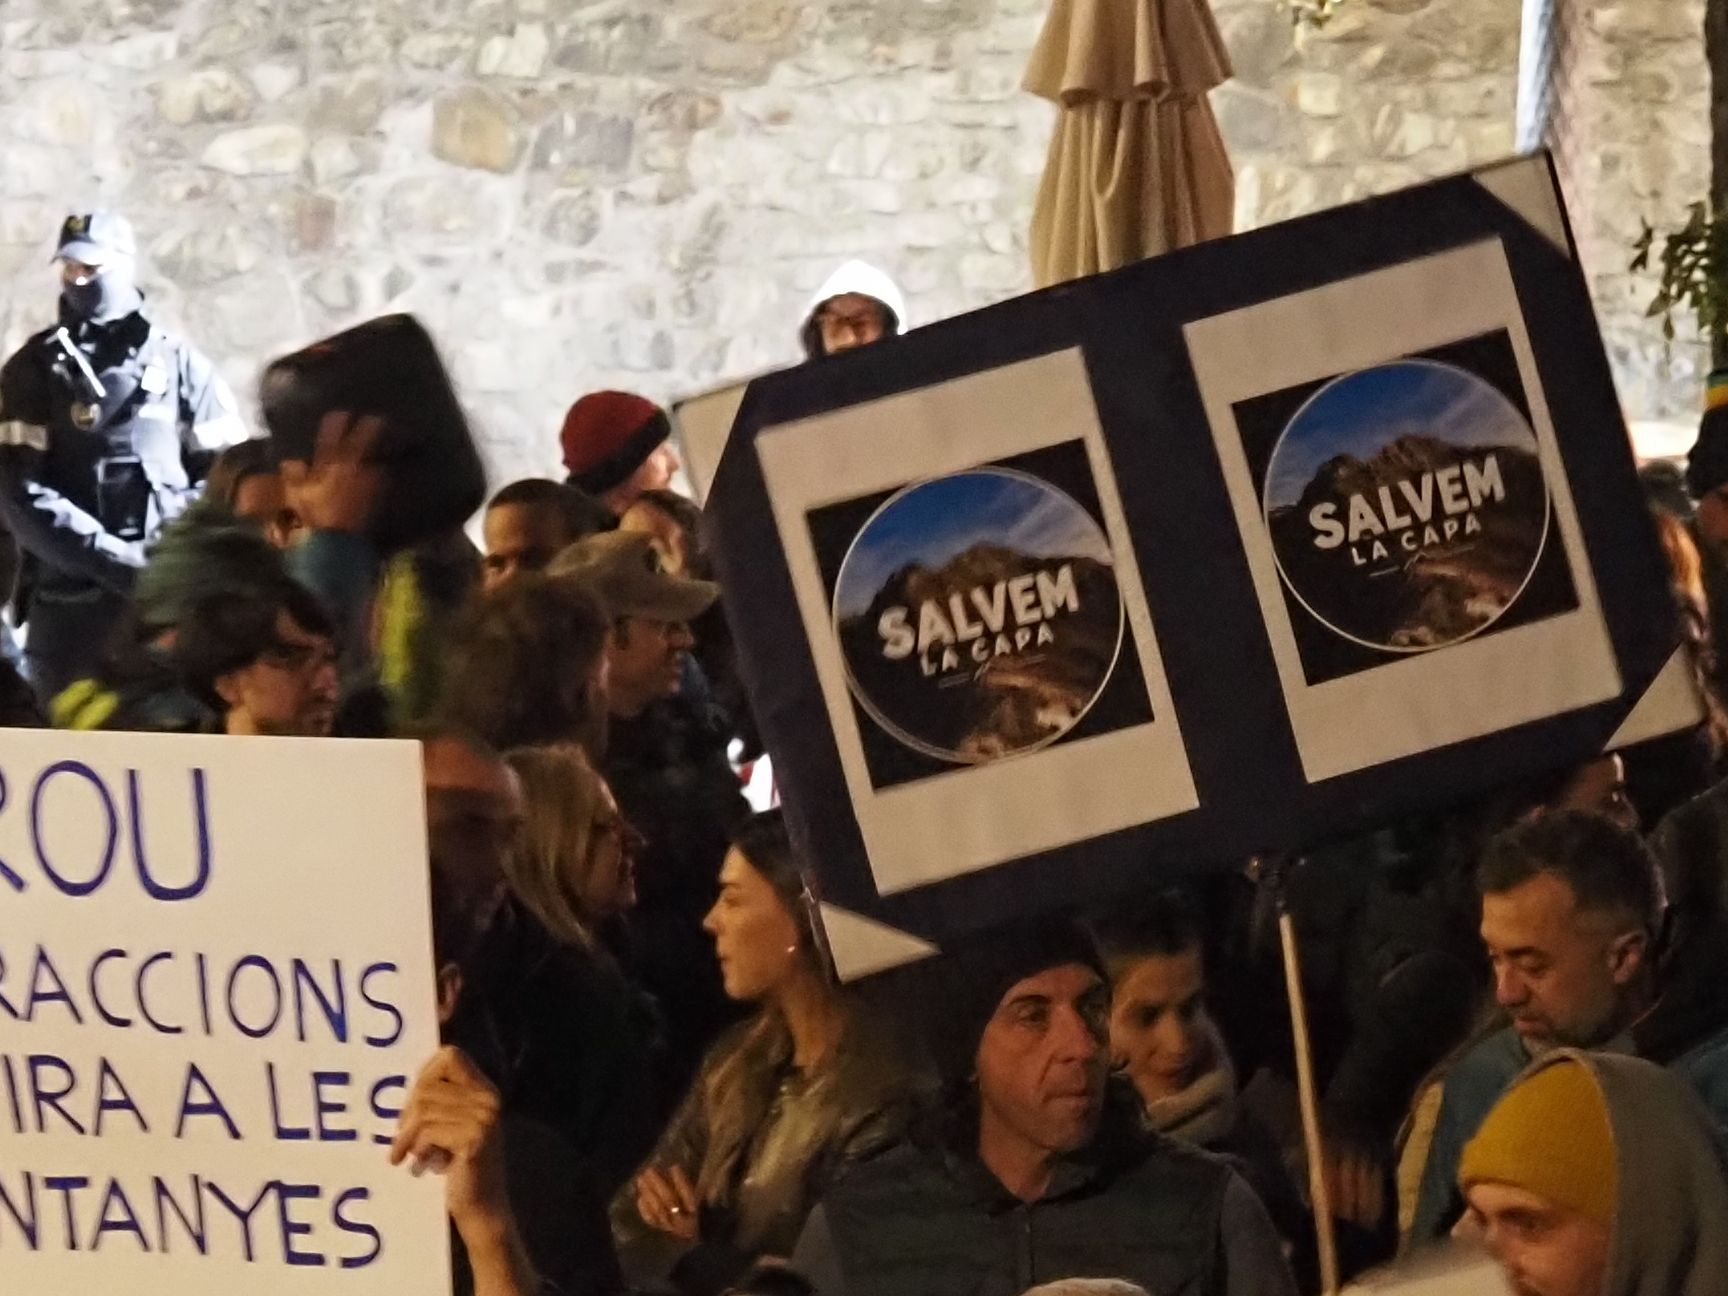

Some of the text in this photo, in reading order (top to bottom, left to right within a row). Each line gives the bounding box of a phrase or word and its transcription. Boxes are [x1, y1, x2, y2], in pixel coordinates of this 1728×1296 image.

[1309, 454, 1506, 550] SALVEM
[1351, 512, 1482, 567] LA CAPA
[877, 564, 1080, 660] SALVEM
[921, 621, 1055, 677] LA CAPA
[174, 1061, 242, 1140] A
[264, 1062, 411, 1146] LES
